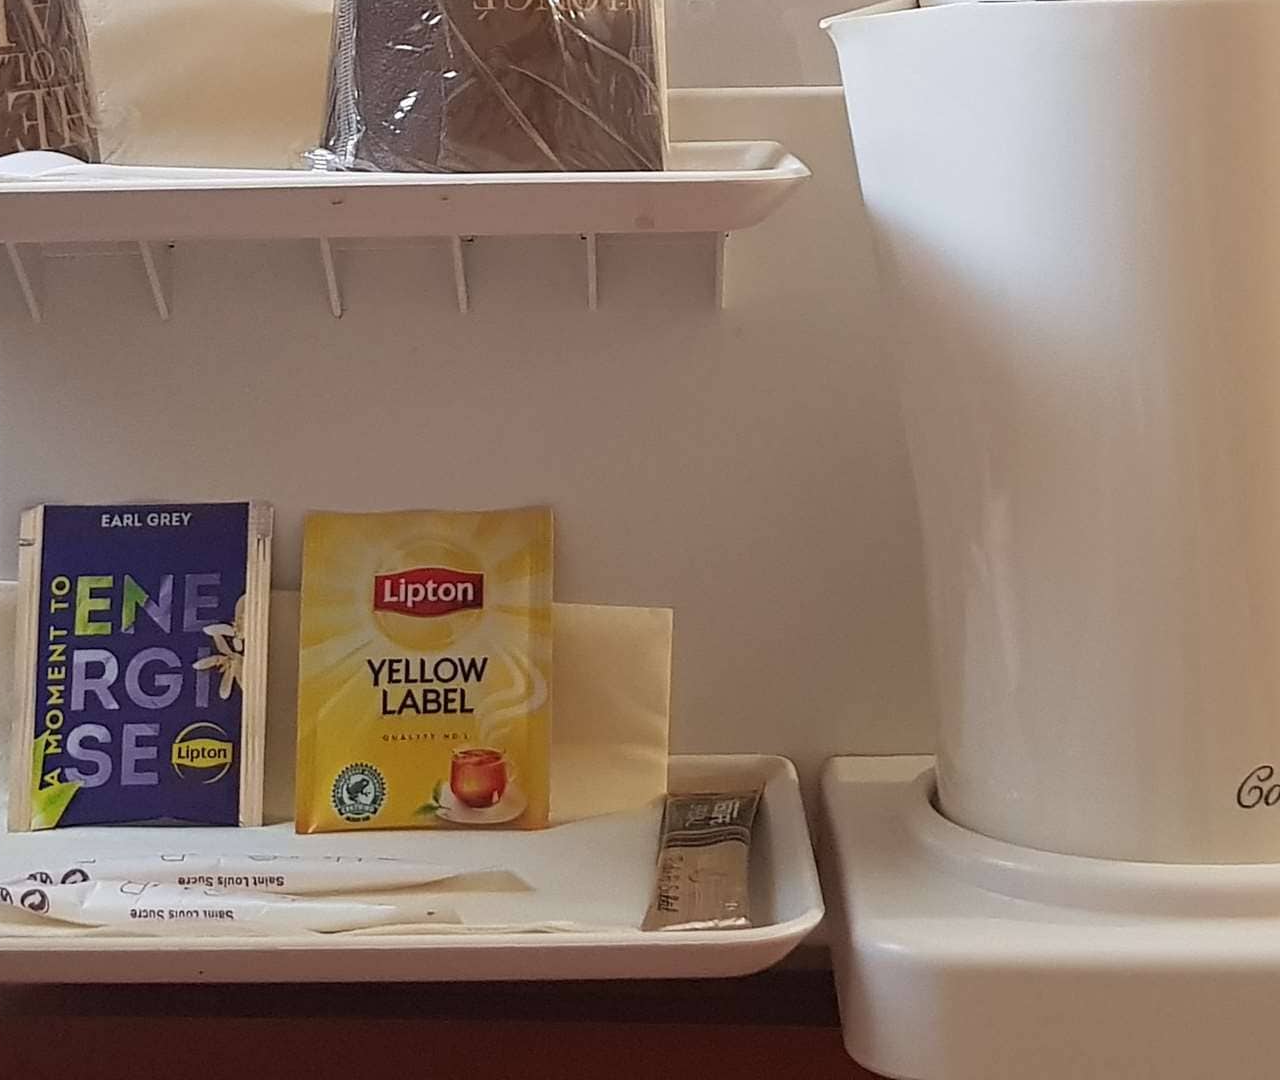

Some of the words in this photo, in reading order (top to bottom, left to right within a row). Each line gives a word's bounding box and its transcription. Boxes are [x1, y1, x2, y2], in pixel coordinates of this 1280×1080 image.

[101, 514, 143, 528] EARL
[146, 512, 193, 527] GREY
[51, 575, 71, 614] TO
[74, 573, 221, 636] ENE
[383, 578, 475, 608] Lipton
[70, 646, 212, 711] RGI
[367, 657, 489, 687] YELLOW
[45, 626, 68, 754] MOMENT
[381, 687, 475, 716] LABEL
[64, 722, 161, 789] SE
[177, 745, 228, 763] Lipton
[43, 767, 62, 788] A
[177, 875, 214, 887] Sucre
[217, 875, 249, 888] Louis
[252, 875, 285, 887] Saint
[130, 908, 165, 920] Sucre
[202, 909, 234, 920] Saint
